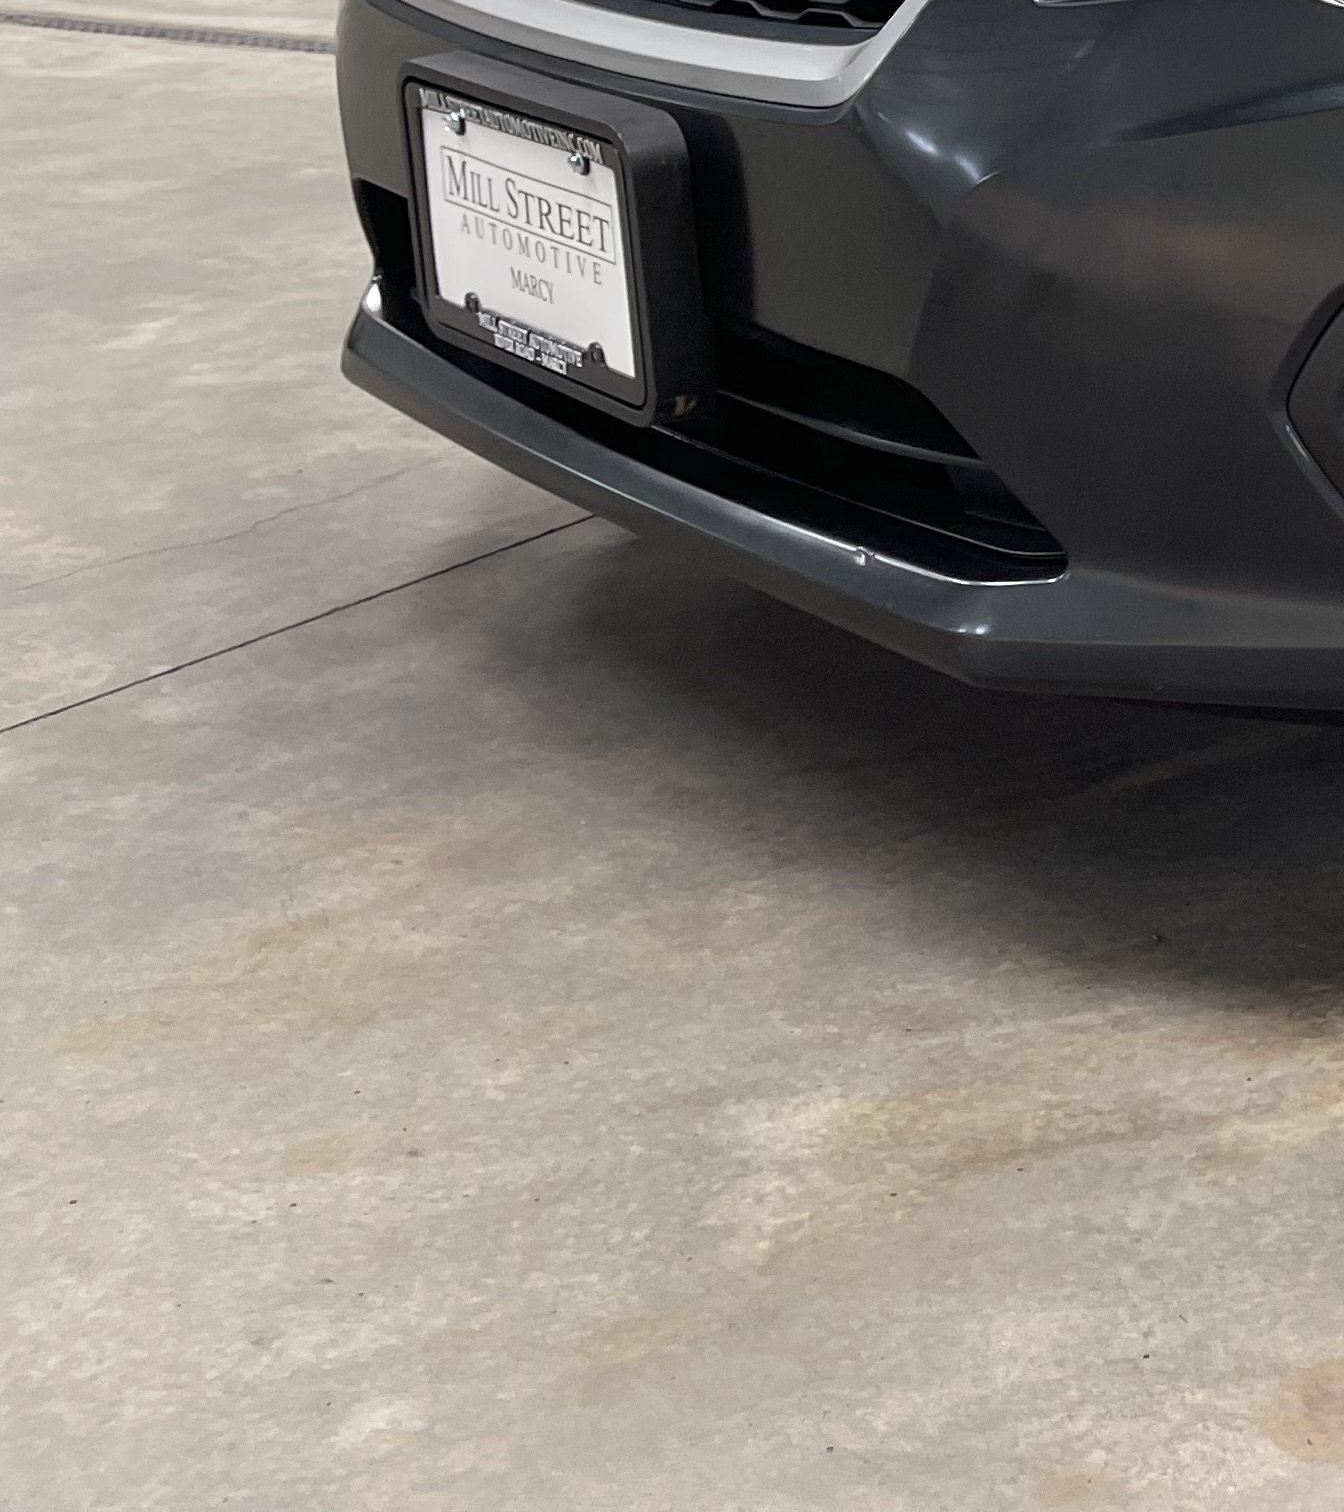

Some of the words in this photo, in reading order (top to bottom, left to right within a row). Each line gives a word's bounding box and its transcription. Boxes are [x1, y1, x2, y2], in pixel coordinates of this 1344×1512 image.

[446, 155, 500, 213] MILL
[505, 177, 610, 254] STREET
[460, 211, 603, 286] AUTOMOTIVE
[510, 266, 555, 305] MARCY
